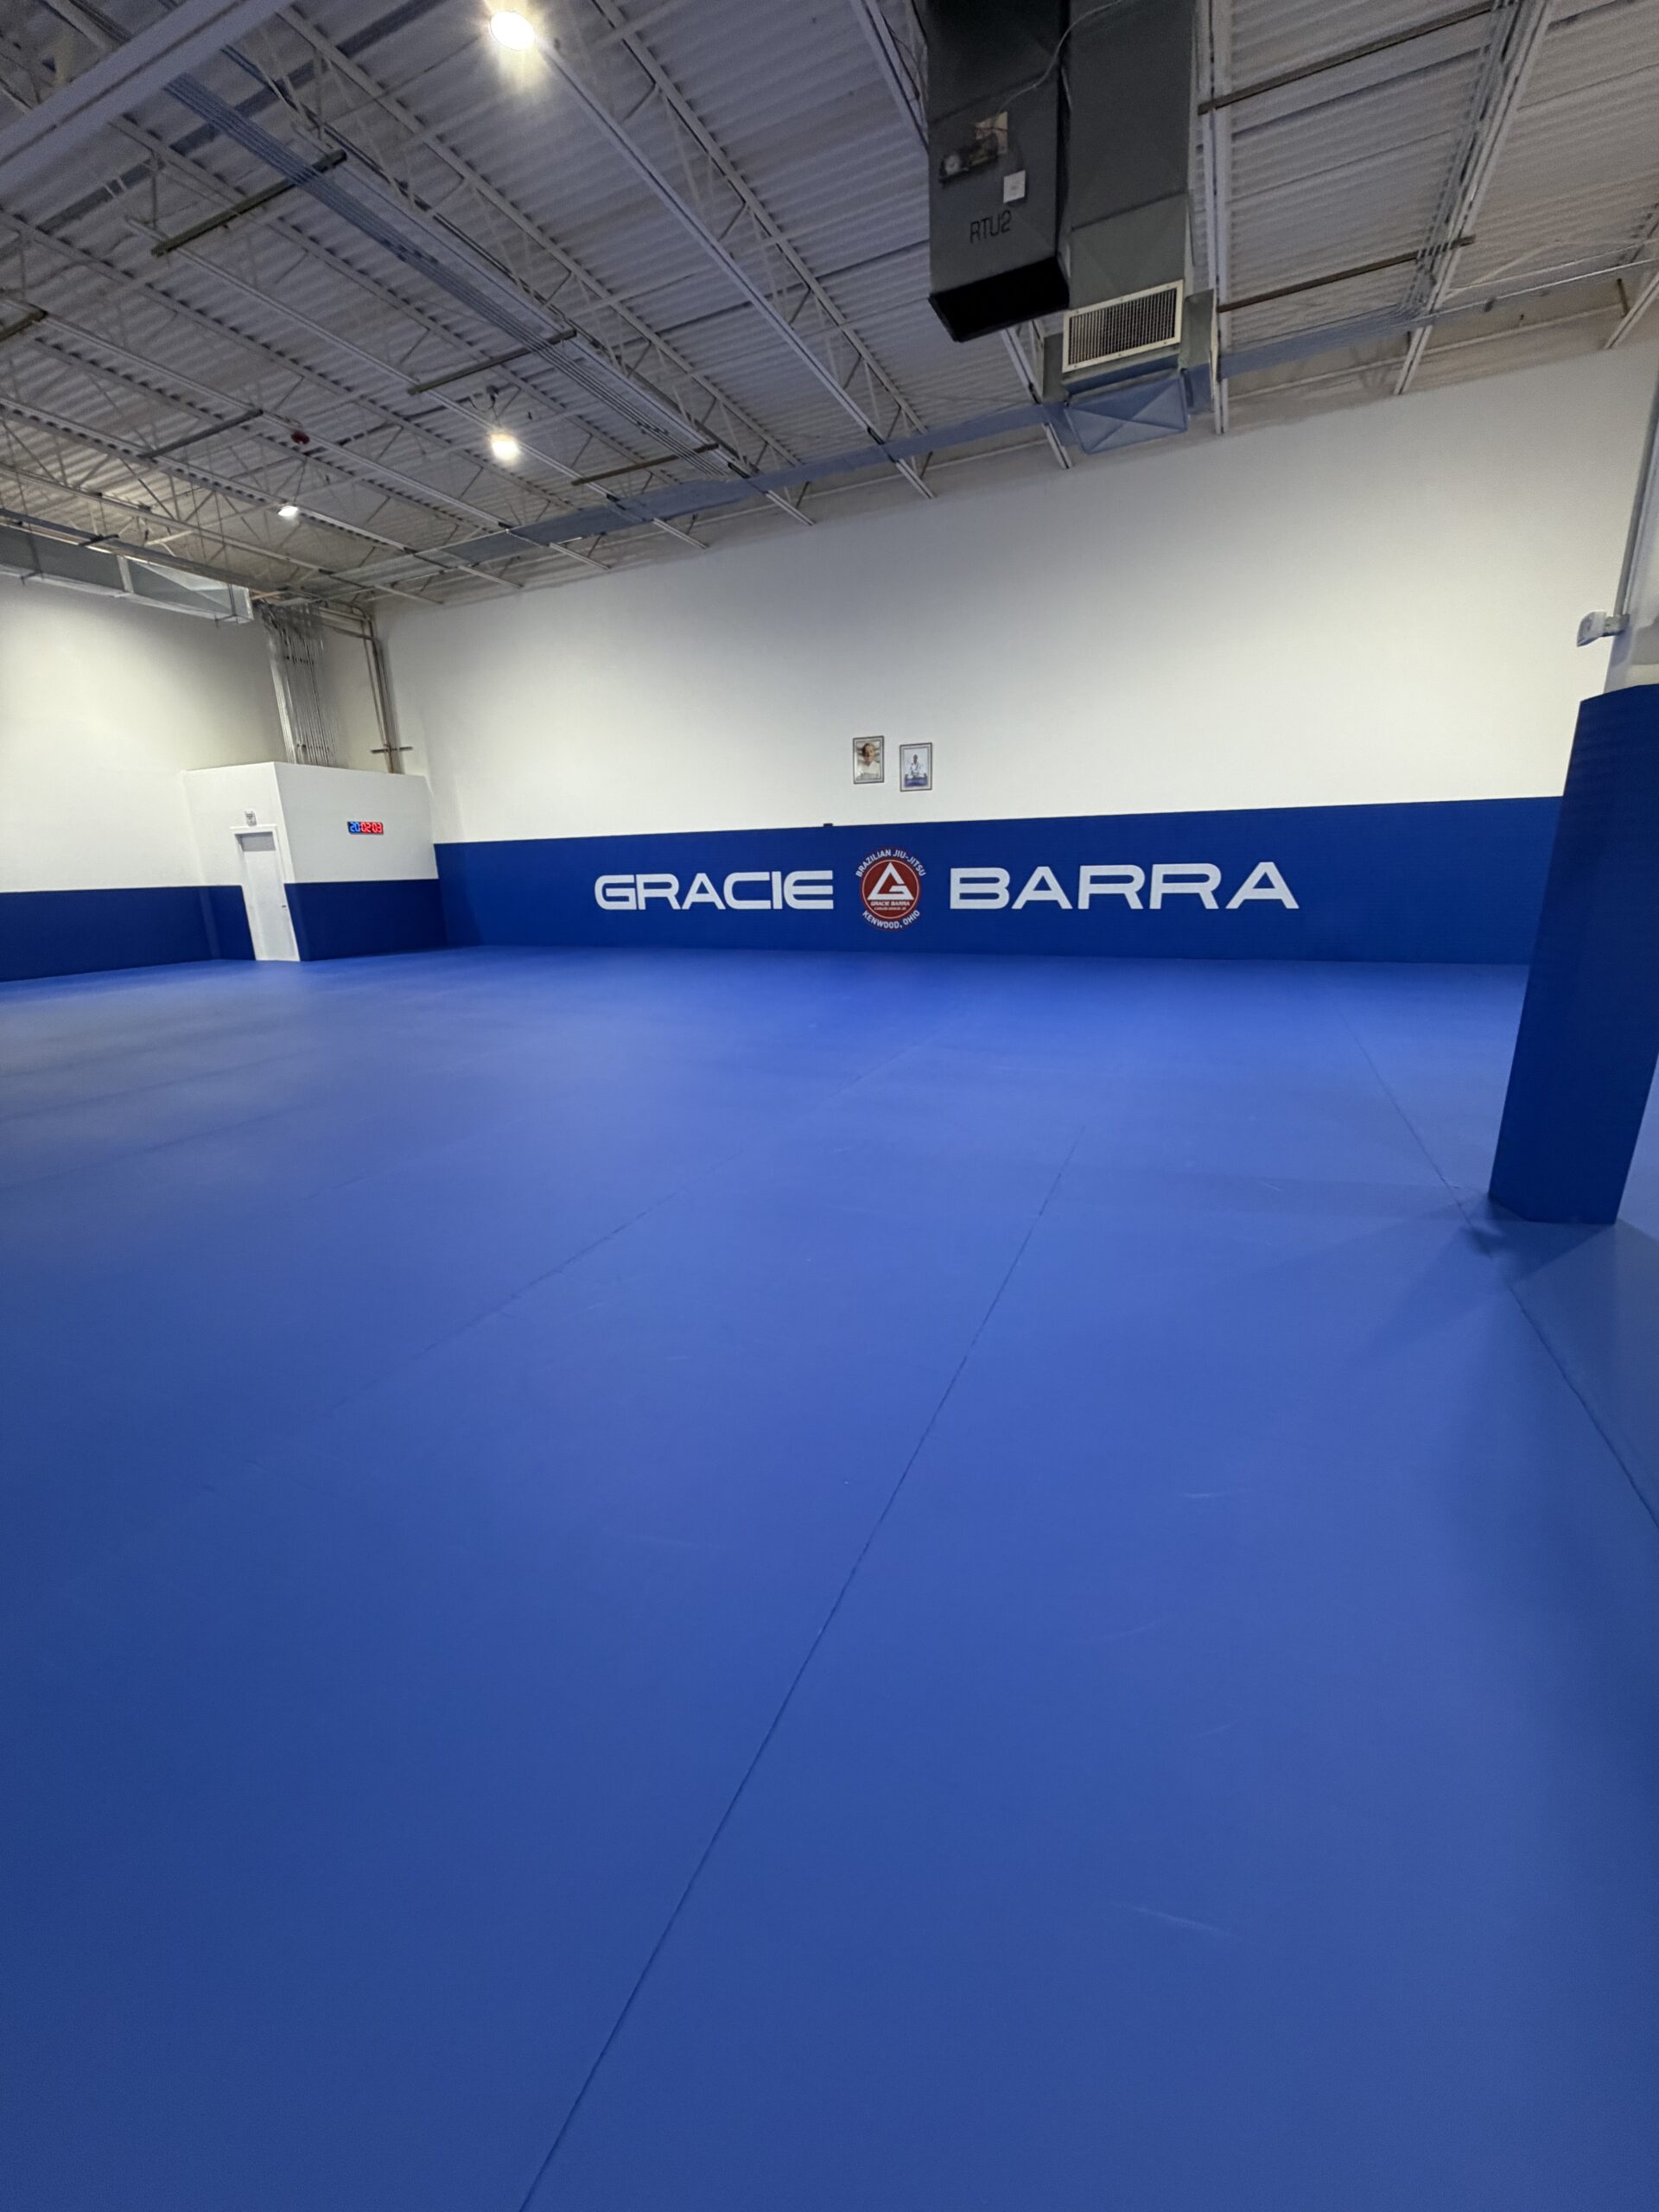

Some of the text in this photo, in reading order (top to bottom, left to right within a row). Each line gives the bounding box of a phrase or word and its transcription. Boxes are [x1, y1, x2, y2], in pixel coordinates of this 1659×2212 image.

[969, 209, 1012, 243] RTU2
[855, 849, 926, 877] BRAZILIAN JIU-JITSU
[594, 861, 1300, 910] GRACIE BARRA
[862, 910, 920, 929] KENWOOD, OHIO
